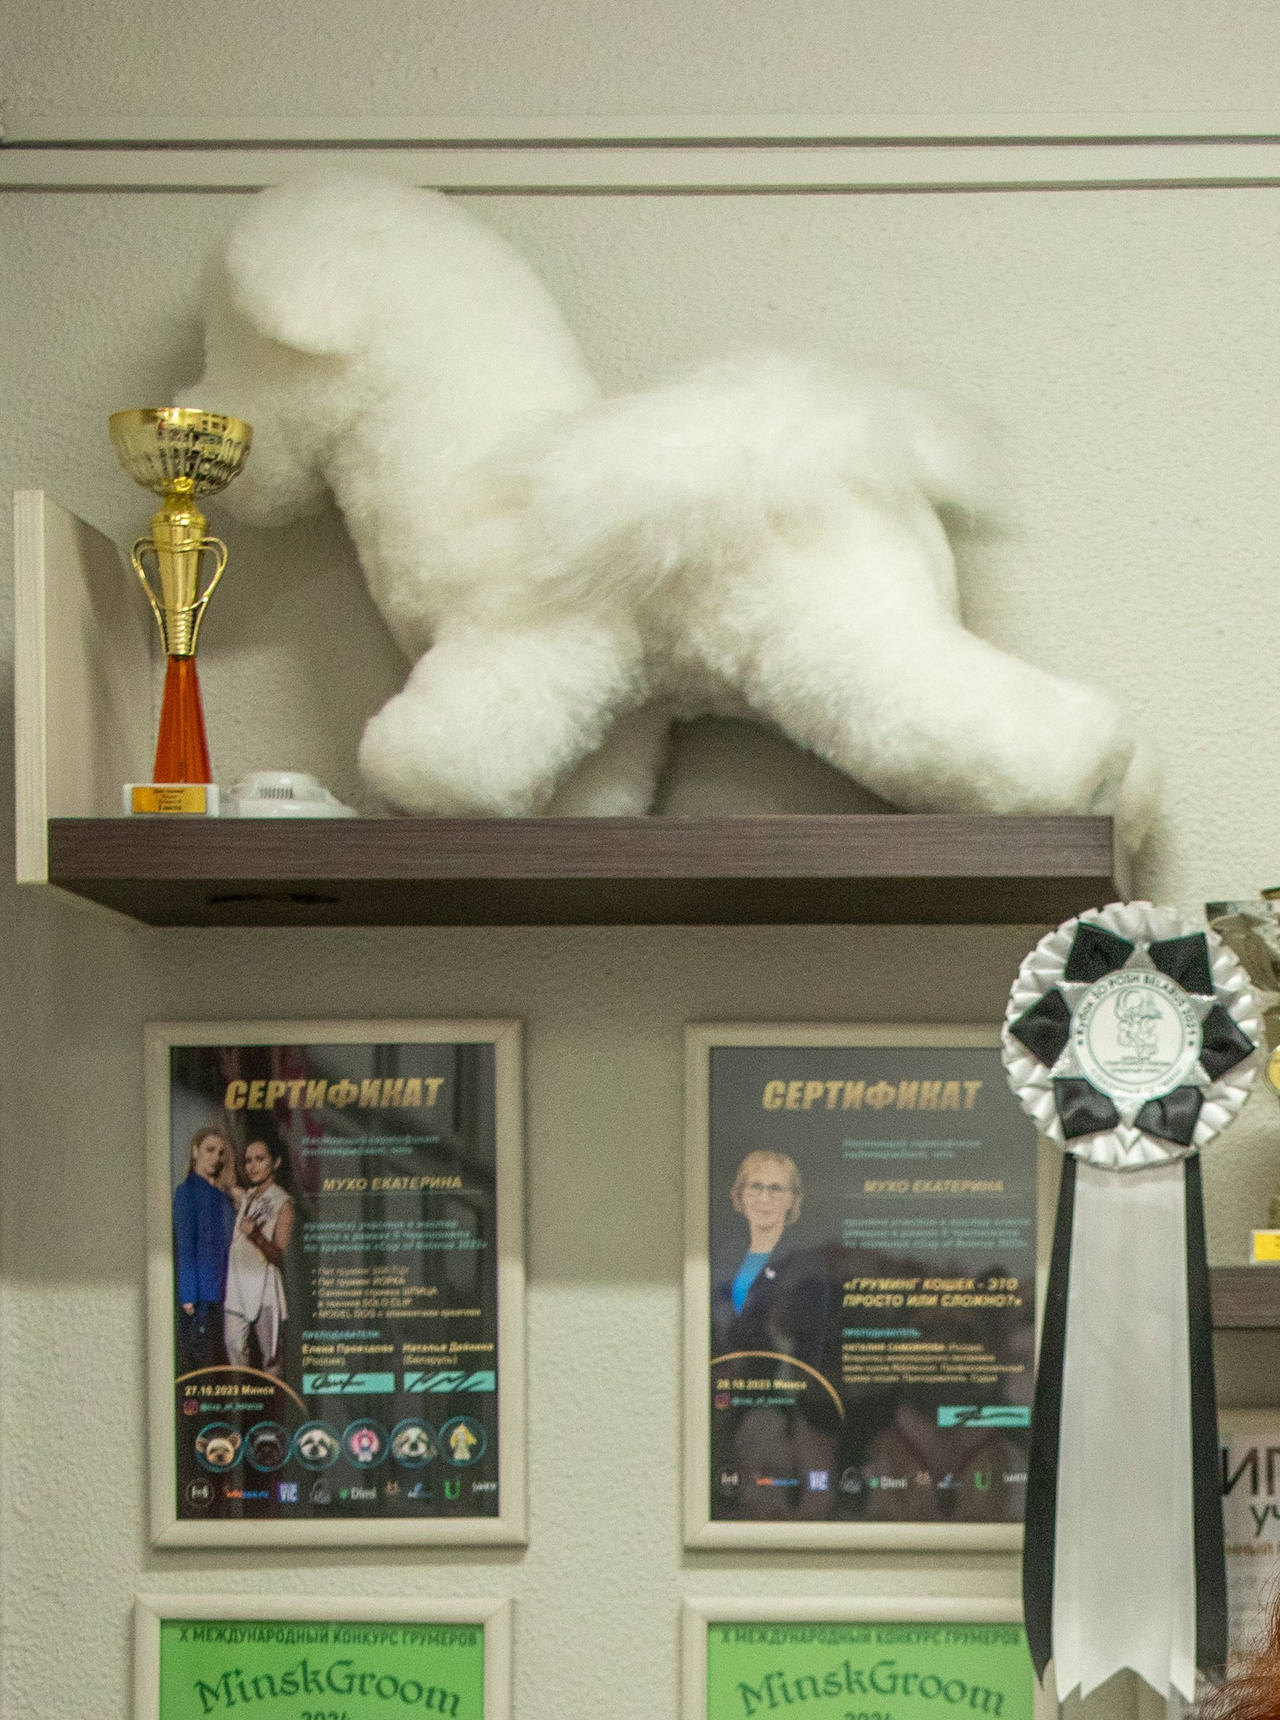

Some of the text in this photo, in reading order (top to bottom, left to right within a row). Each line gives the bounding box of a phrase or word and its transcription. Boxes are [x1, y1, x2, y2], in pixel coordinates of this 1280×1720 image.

[224, 1077, 445, 1111] СЕРТИФИКАТ
[761, 1080, 983, 1112] СЕРТИФИКАТ
[322, 1176, 463, 1192] МУХО ЕКАТЕРИНА
[922, 1277, 975, 1292] КОШЕК
[842, 1294, 904, 1307] ПРОСТО
[907, 1294, 938, 1307] ИЛИ
[191, 1627, 329, 1645] МЕЖДУНАРОДНЫЙ
[333, 1629, 399, 1646] КОНКУРС
[401, 1630, 478, 1647] ГРУМЕРОВ
[194, 1658, 460, 1718] MinskGroom
[737, 1659, 1005, 1718] MinskGroom
